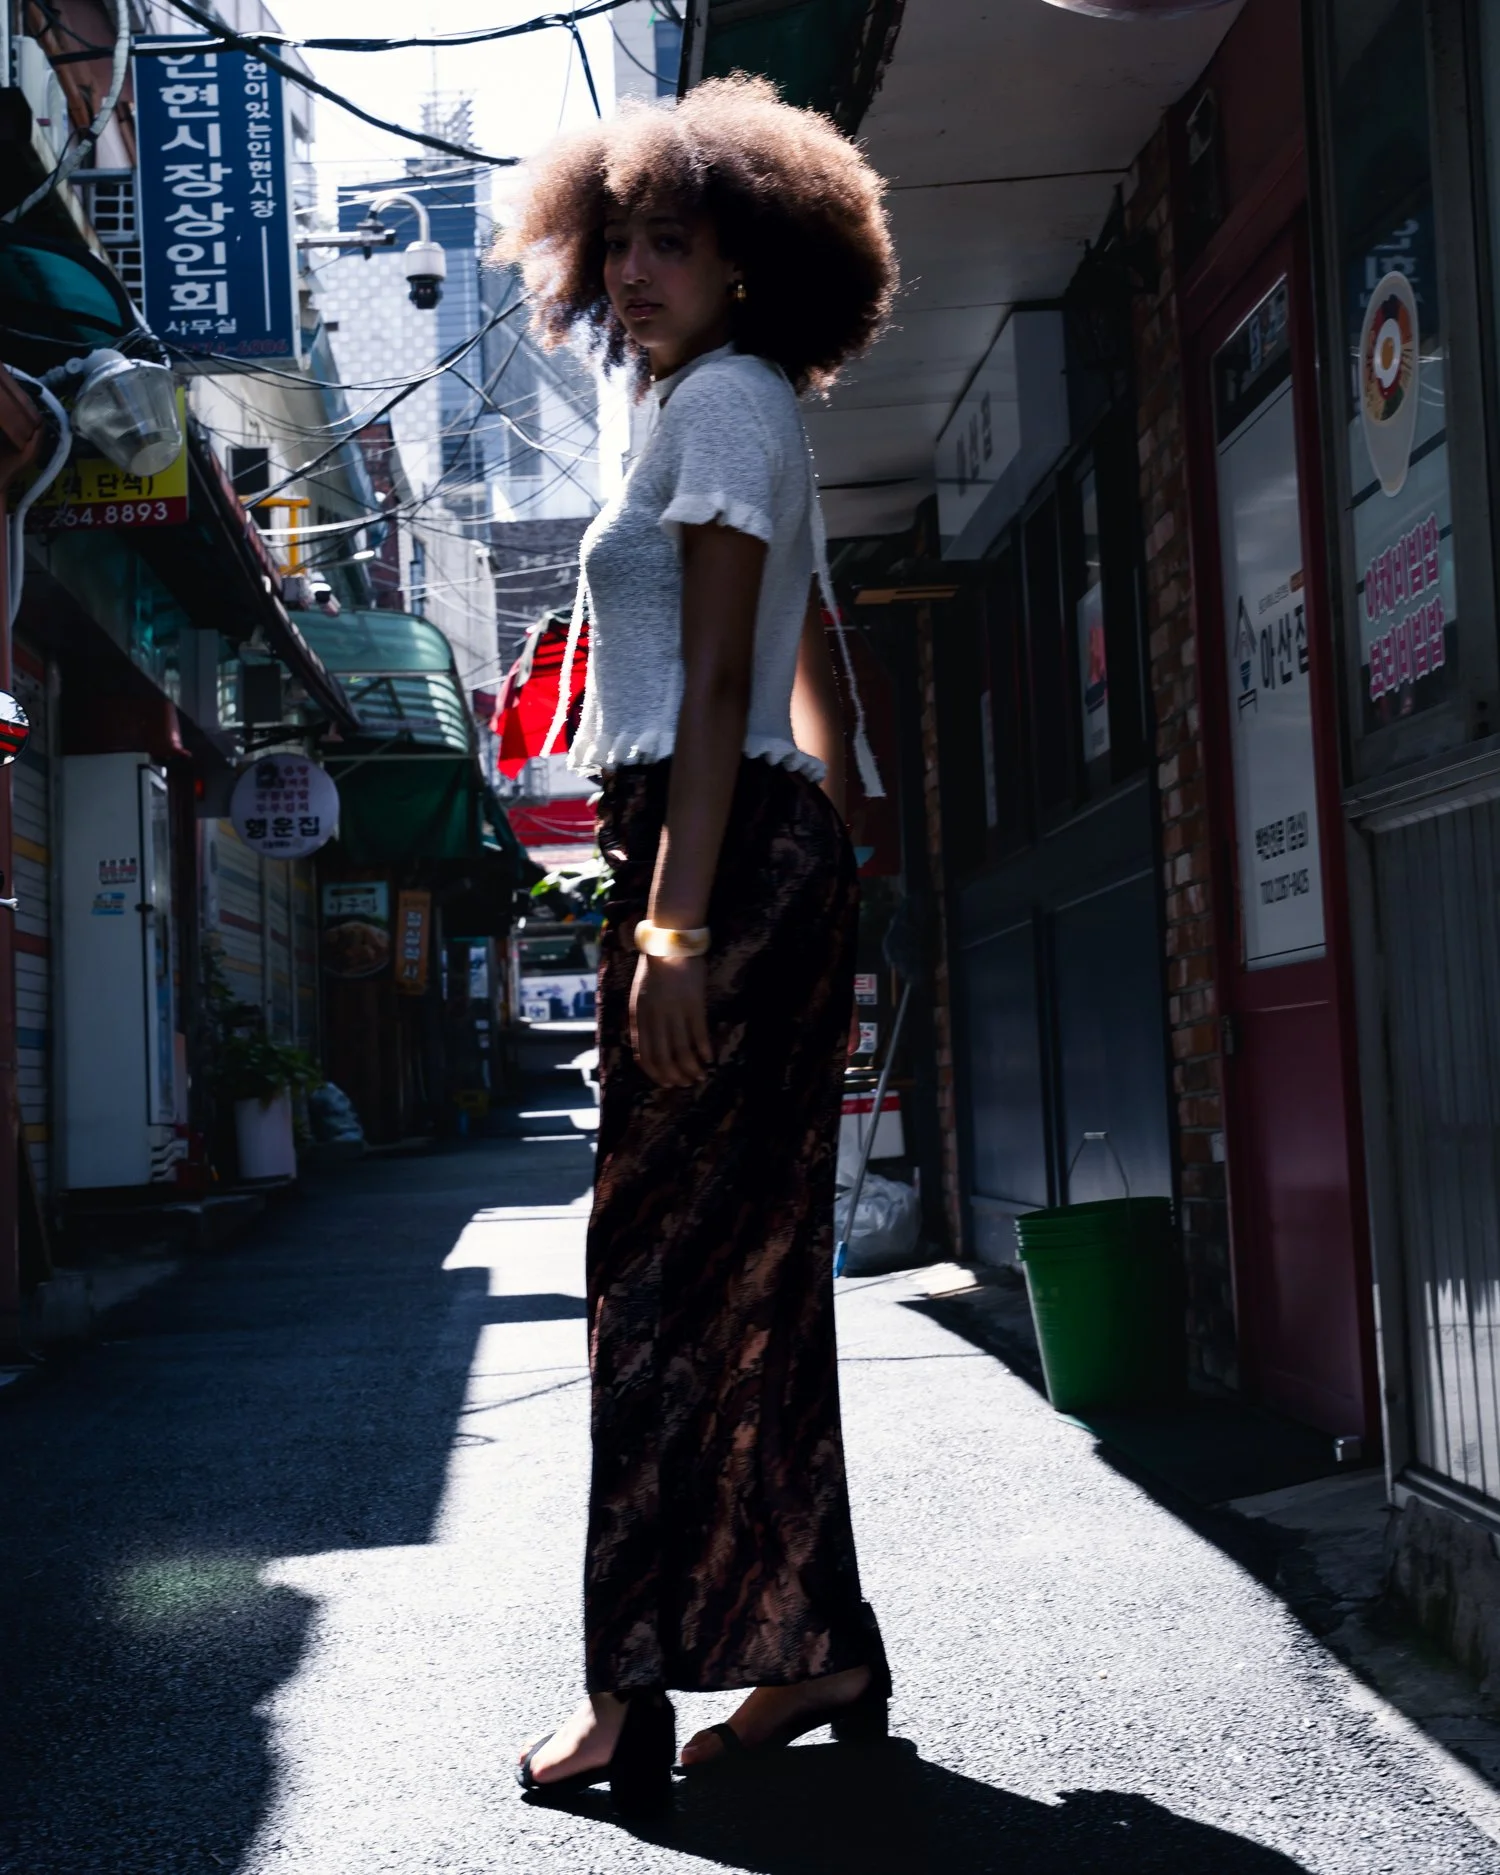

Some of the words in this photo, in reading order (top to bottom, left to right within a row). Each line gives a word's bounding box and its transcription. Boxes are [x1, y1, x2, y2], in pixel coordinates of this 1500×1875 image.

[157, 52, 235, 316] 인현시장상인회
[242, 53, 277, 219] 연이있는인현시장
[164, 317, 238, 337] 사무실
[1365, 512, 1440, 625] 야채비빔밥
[1369, 593, 1446, 702] 보리비빔밥
[245, 815, 319, 839] 행운집
